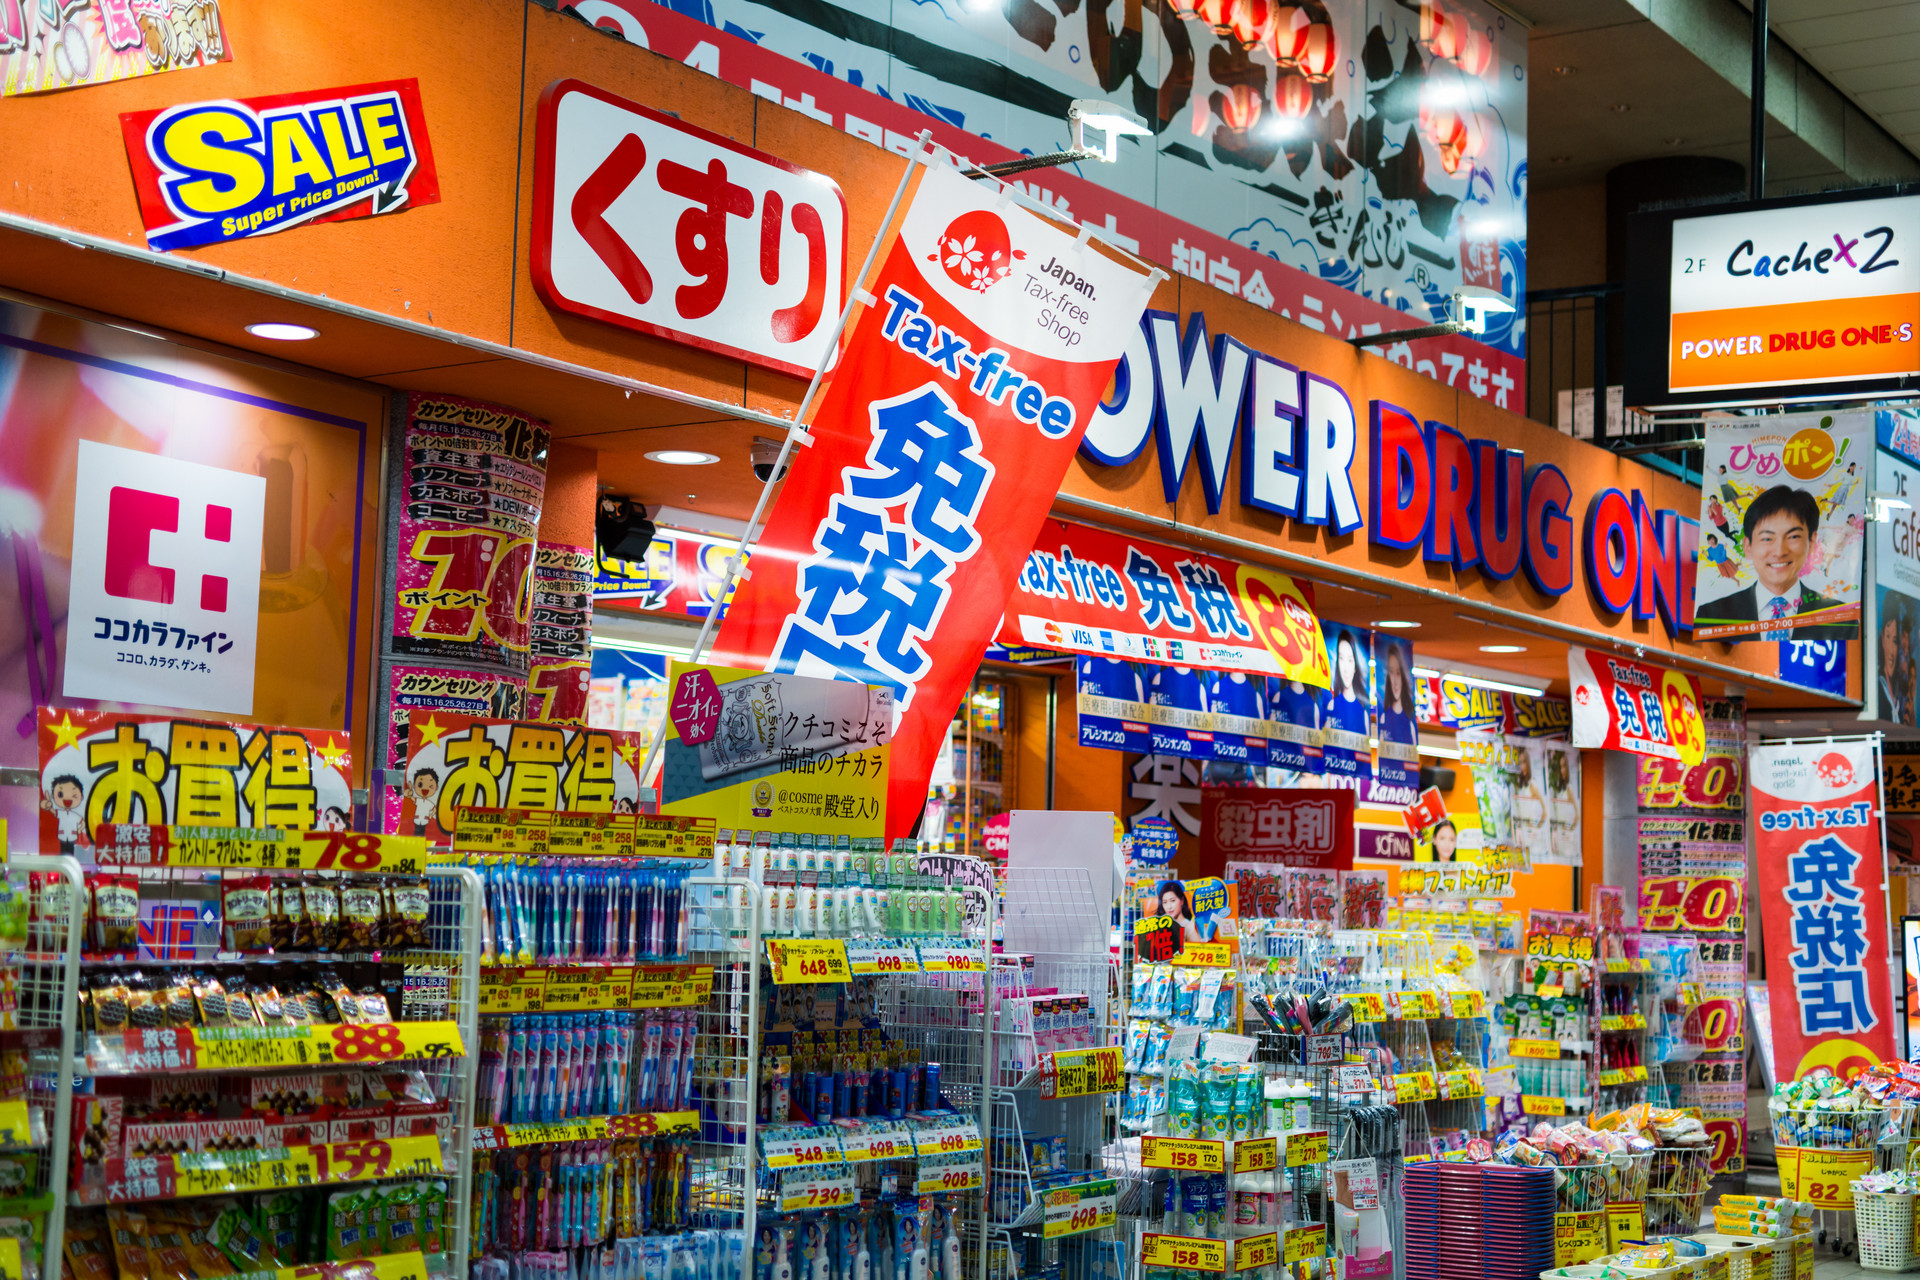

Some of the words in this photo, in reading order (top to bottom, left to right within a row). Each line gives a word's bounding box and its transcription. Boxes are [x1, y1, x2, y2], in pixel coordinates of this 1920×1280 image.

[164, 102, 406, 213] SALE
[221, 200, 287, 238] Super
[290, 186, 333, 213] Price
[336, 169, 380, 197] Down!
[571, 132, 833, 344] くすり
[1684, 257, 1707, 274] 2F
[1040, 257, 1097, 301] Japan.
[1023, 273, 1089, 325] Tax-free
[1036, 308, 1081, 347] Shop
[1682, 335, 1763, 360] POWER
[1769, 328, 1836, 353] DRUG
[881, 288, 1076, 438] Tax-free
[416, 400, 511, 432] カウンセリング
[1752, 434, 1788, 445] HIMEPON
[1078, 308, 1363, 536] OWER
[1369, 400, 1574, 597] DRUG
[421, 466, 487, 487] ソフィーナ
[417, 485, 484, 505] カネボウ
[417, 504, 484, 521] コーセー
[1019, 549, 1127, 609] ax-free
[405, 591, 488, 607] ポイント
[1127, 549, 1250, 638] 免税
[94, 616, 234, 655] ココカラファイン
[1071, 628, 1095, 648] VISA
[117, 652, 212, 674] ココロ、カラダ、ゲンキ。
[1608, 661, 1652, 687] Tax-free
[400, 674, 495, 699] カウンセリング
[1443, 680, 1503, 719] SALE
[1515, 693, 1570, 729] SALE
[1615, 685, 1667, 741] 免税
[689, 721, 706, 740] 効く
[784, 711, 887, 747] クチコミこそ
[1082, 727, 1126, 744] アレジオン20
[1152, 736, 1192, 752] アレジオン20
[780, 744, 883, 780] 商品のチカラ
[85, 721, 318, 845] お買得
[438, 723, 615, 834] お買得
[778, 789, 823, 805] @cosme
[778, 805, 823, 816] ベストコスメ大賞
[824, 793, 880, 821] 殿堂入り
[1403, 787, 1446, 837] NEW
[115, 825, 151, 843] 激安
[501, 829, 515, 841] 98
[528, 829, 547, 842] 258
[1218, 803, 1332, 849] 殺虫剤
[1688, 821, 1743, 841] 化粧品
[590, 832, 602, 843] 98
[615, 831, 632, 844] 258
[673, 835, 684, 846] 98
[695, 835, 712, 847] 258
[97, 844, 164, 865] 大特価！
[303, 832, 382, 871] 78
[533, 842, 547, 854] 278
[620, 844, 633, 855] 278
[699, 847, 712, 858] 278
[1195, 896, 1225, 914] 耐久型
[1643, 876, 1742, 931] 10
[1134, 915, 1173, 935] 通常の
[1190, 950, 1214, 964] 798
[1528, 934, 1594, 961] お買得
[800, 959, 828, 976] 648
[827, 959, 843, 968] 699
[877, 955, 901, 971] 698
[947, 955, 971, 970] 980
[497, 989, 509, 1000] 63
[524, 987, 541, 1000] 184
[588, 987, 599, 998] 63
[612, 985, 628, 997] 184
[671, 984, 683, 995] 63
[694, 983, 710, 995] 184
[527, 1000, 541, 1011] 198
[615, 997, 629, 1008] 198
[141, 1029, 178, 1049] 激安
[331, 1023, 405, 1062] 88
[127, 1125, 196, 1143] MACADAMIA
[199, 1119, 264, 1143] MACADAMIA
[605, 1113, 659, 1138] 88
[869, 1140, 895, 1157] 698
[940, 1135, 964, 1152] 698
[308, 1139, 392, 1183] 159
[794, 1146, 823, 1163] 548
[1171, 1151, 1198, 1167] 158
[1203, 1154, 1218, 1163] 170
[1249, 1152, 1264, 1167] 158
[1303, 1147, 1317, 1162] 278
[123, 1157, 159, 1177] 激安
[1820, 1168, 1849, 1177] じゃがりこ
[107, 1178, 172, 1200] 大特価！
[942, 1171, 969, 1188] 908
[807, 1187, 841, 1206] 739
[1808, 1182, 1840, 1201] 82
[1071, 1206, 1098, 1230] 698
[1172, 1249, 1200, 1266] 158
[1204, 1253, 1220, 1262] 170
[1250, 1248, 1264, 1264] 158
